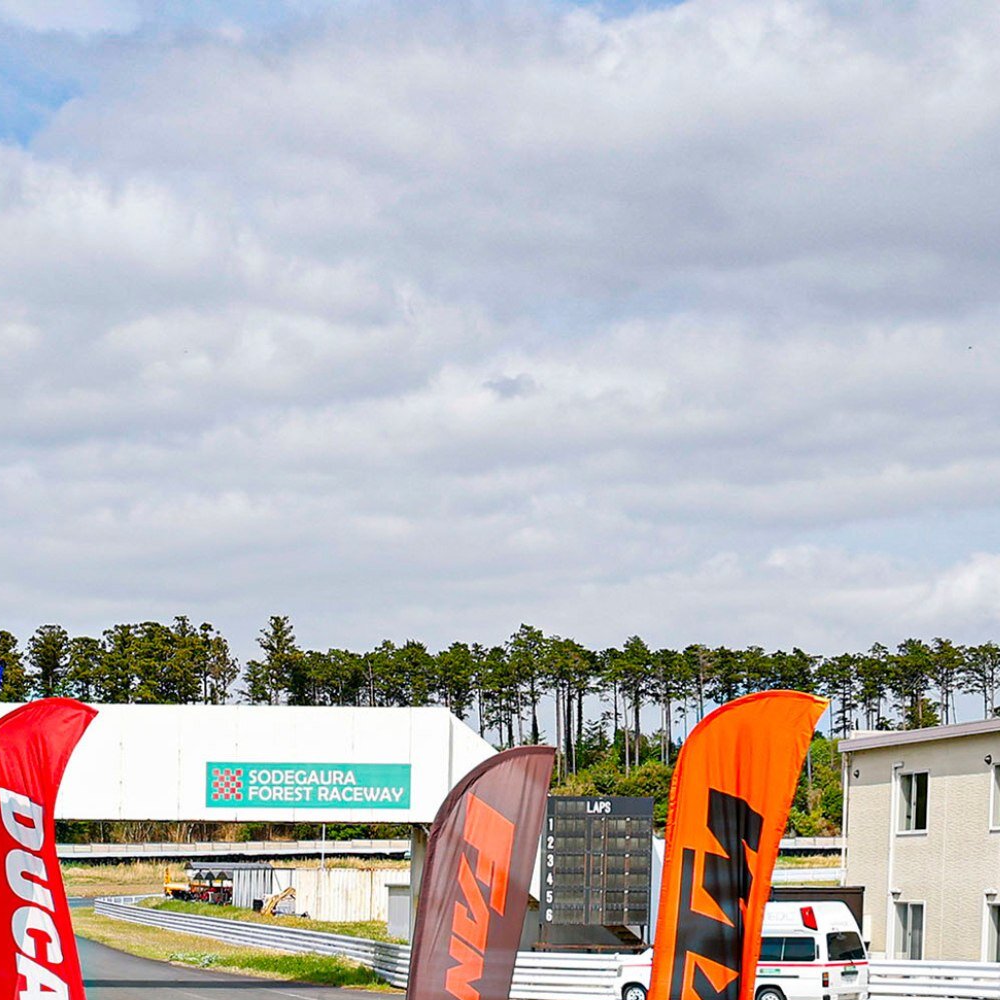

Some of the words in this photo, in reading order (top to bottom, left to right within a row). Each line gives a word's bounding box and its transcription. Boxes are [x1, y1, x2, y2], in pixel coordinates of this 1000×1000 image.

[249, 769, 357, 785] SODEGAURA
[248, 786, 312, 801] FOREST
[317, 786, 405, 802] RACEWAY
[586, 801, 612, 814] LAPS
[548, 817, 554, 831] 1
[547, 836, 555, 849] 2
[546, 854, 554, 867] 3
[546, 872, 554, 885] 4
[545, 891, 553, 903] 5
[545, 909, 553, 922] 6
